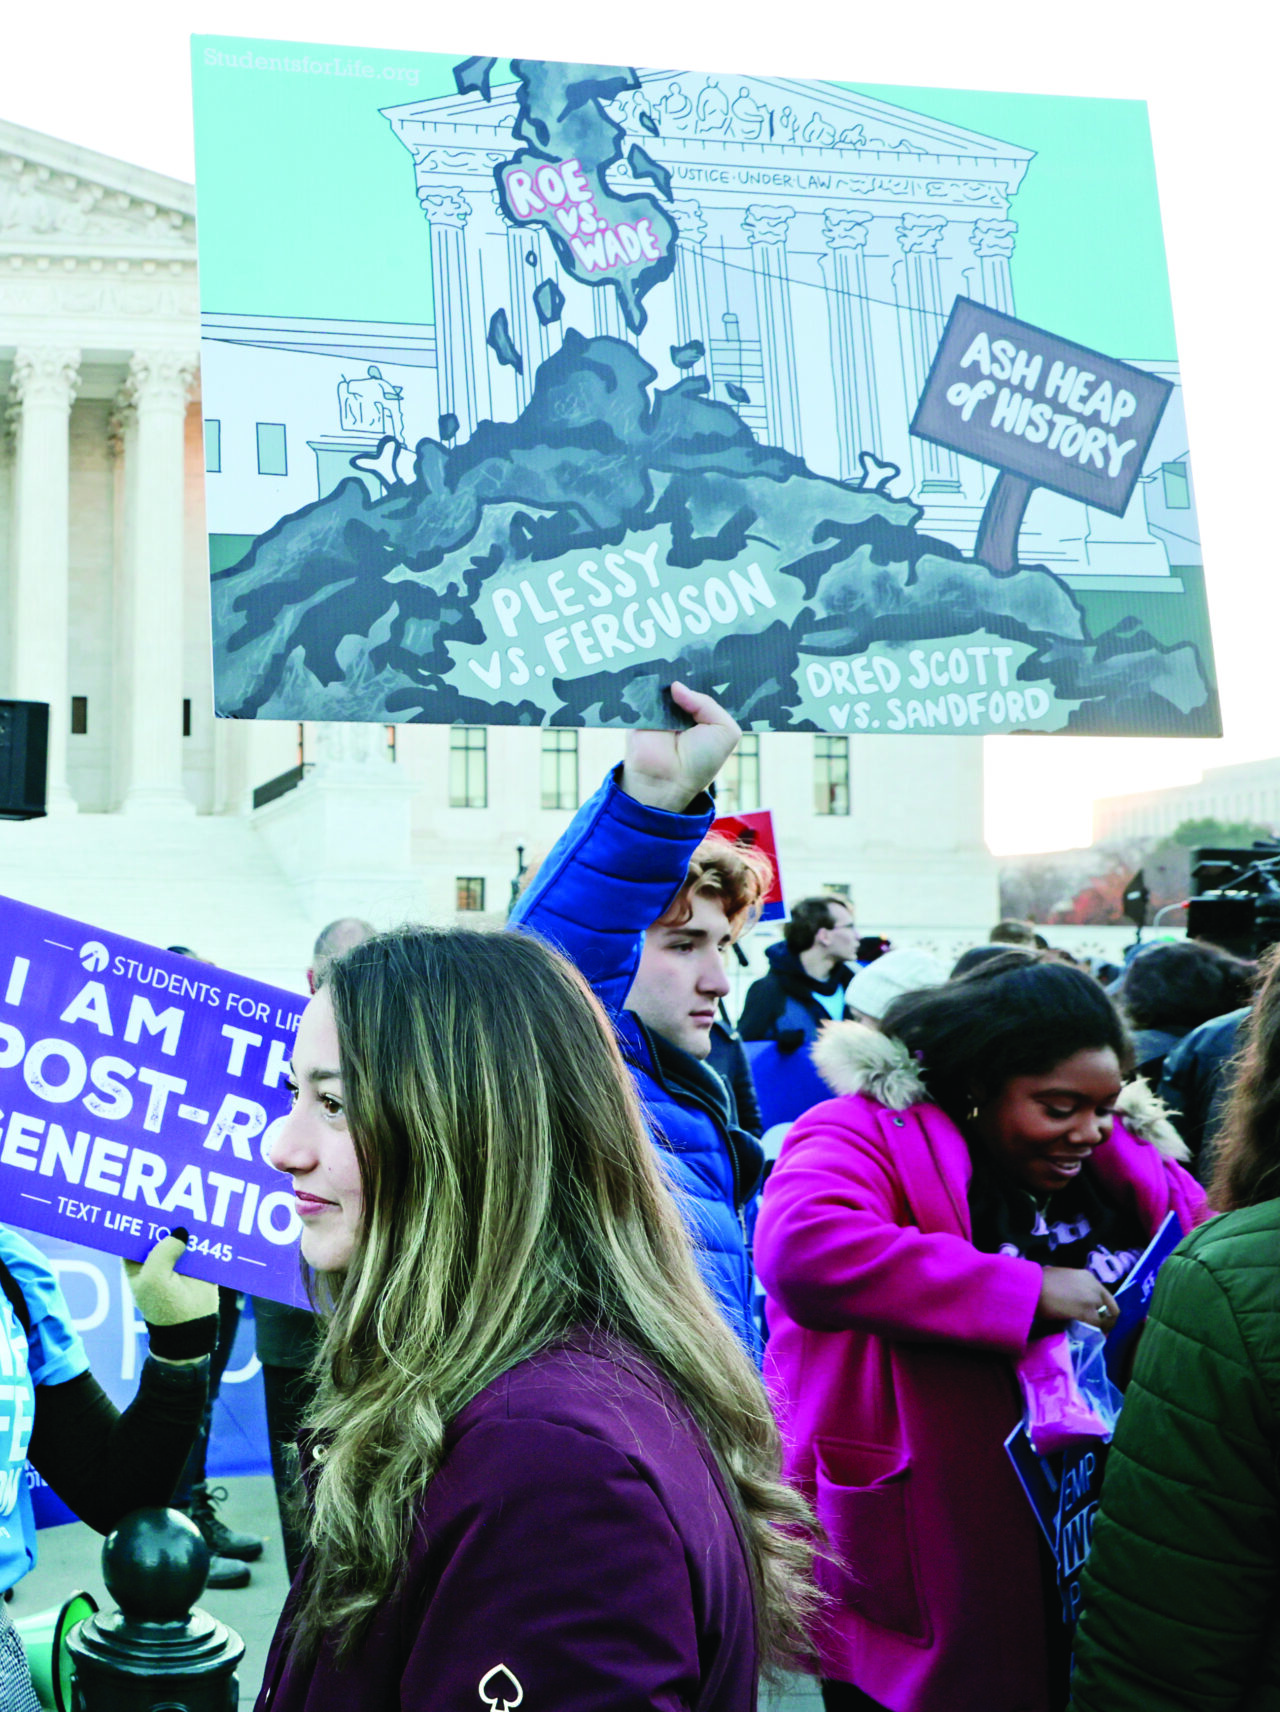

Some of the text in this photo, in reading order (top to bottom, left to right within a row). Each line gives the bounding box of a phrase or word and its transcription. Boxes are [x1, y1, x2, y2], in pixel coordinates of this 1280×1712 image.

[203, 48, 421, 86] StudentsforLife.org
[506, 159, 595, 217] ROE
[570, 218, 662, 272] WADE
[960, 332, 1137, 427] ASH HEAP
[946, 379, 1137, 478] of HISTORY
[491, 541, 663, 638] PLESSY
[468, 563, 777, 690] VS. FERGUSON
[805, 646, 1013, 698] DRED SCOTT
[827, 687, 1051, 732] VS. SANDFORD
[5, 956, 30, 1006] I
[60, 980, 185, 1056] AM
[113, 956, 221, 1007] STUDENTS
[226, 993, 270, 1023] FOR
[58, 1197, 233, 1262] TEXT LIFE TO 3445
